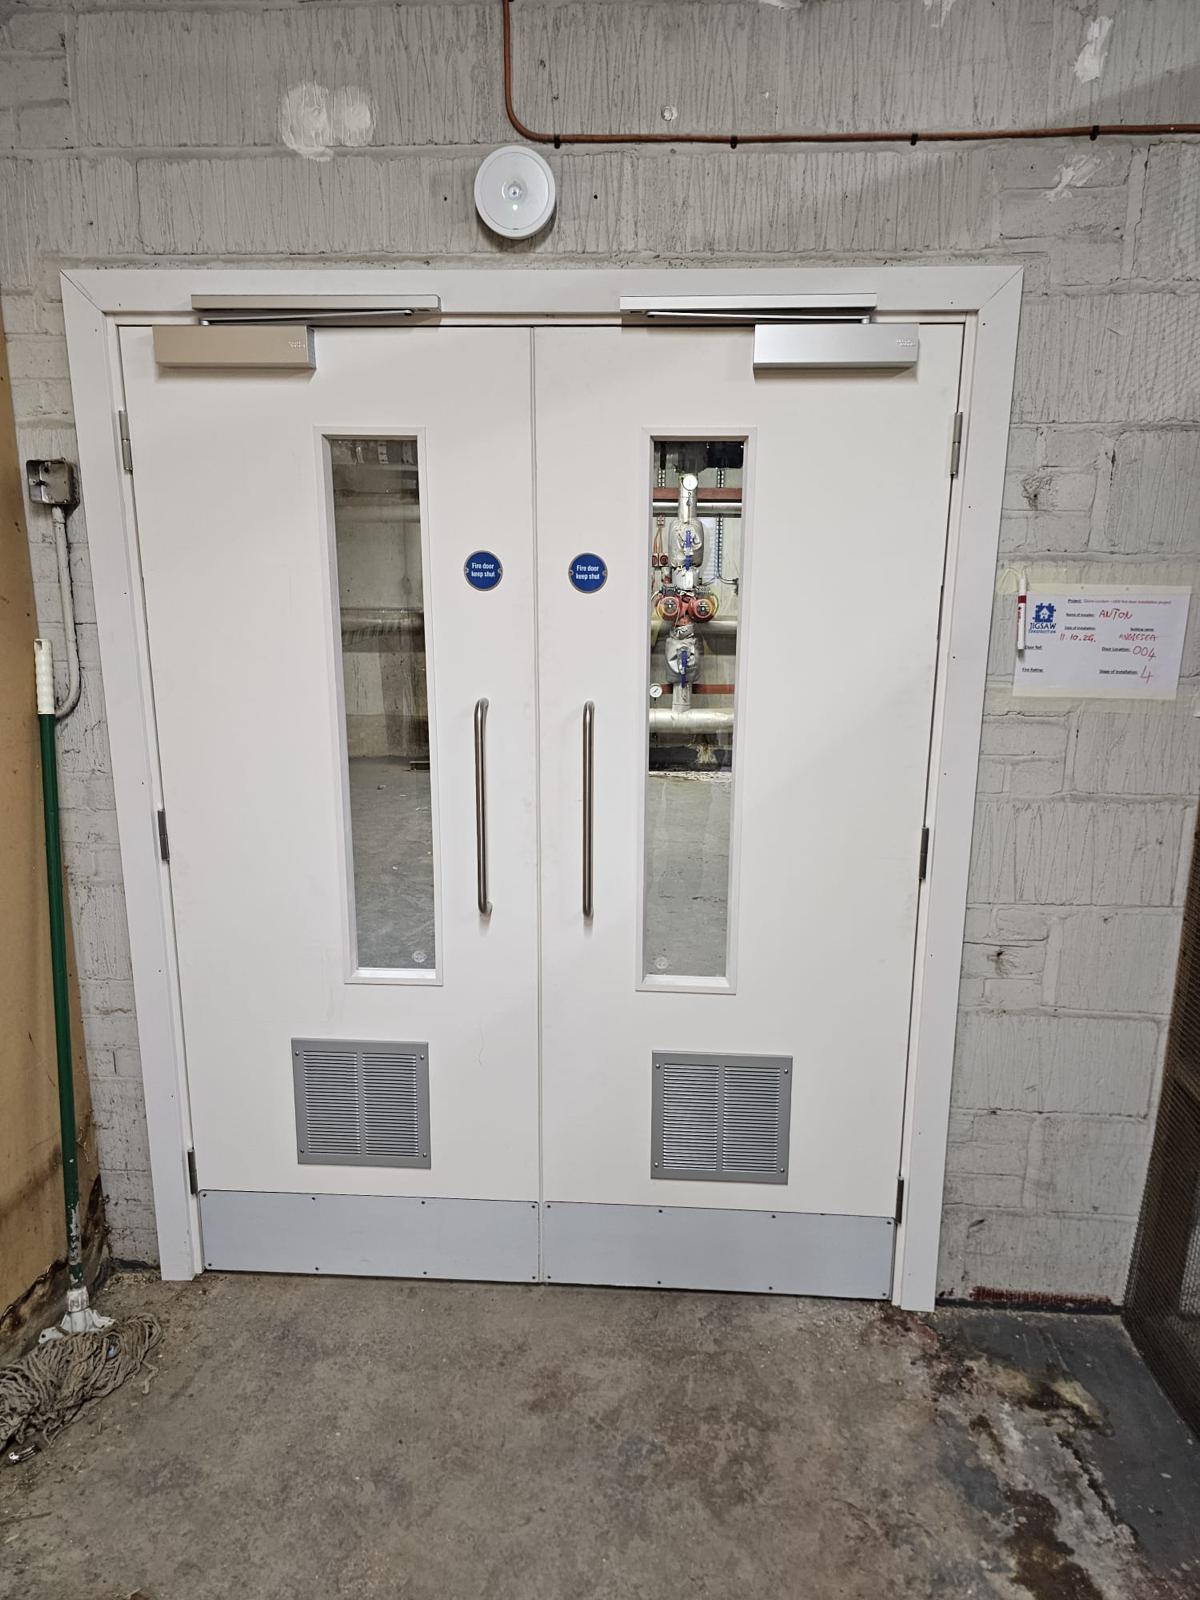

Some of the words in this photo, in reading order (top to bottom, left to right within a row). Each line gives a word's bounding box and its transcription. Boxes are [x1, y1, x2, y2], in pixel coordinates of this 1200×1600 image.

[1099, 607, 1133, 621] ANTON
[1030, 622, 1056, 630] JIGSAW
[1132, 645, 1157, 661] 004
[1140, 665, 1153, 684] 4
